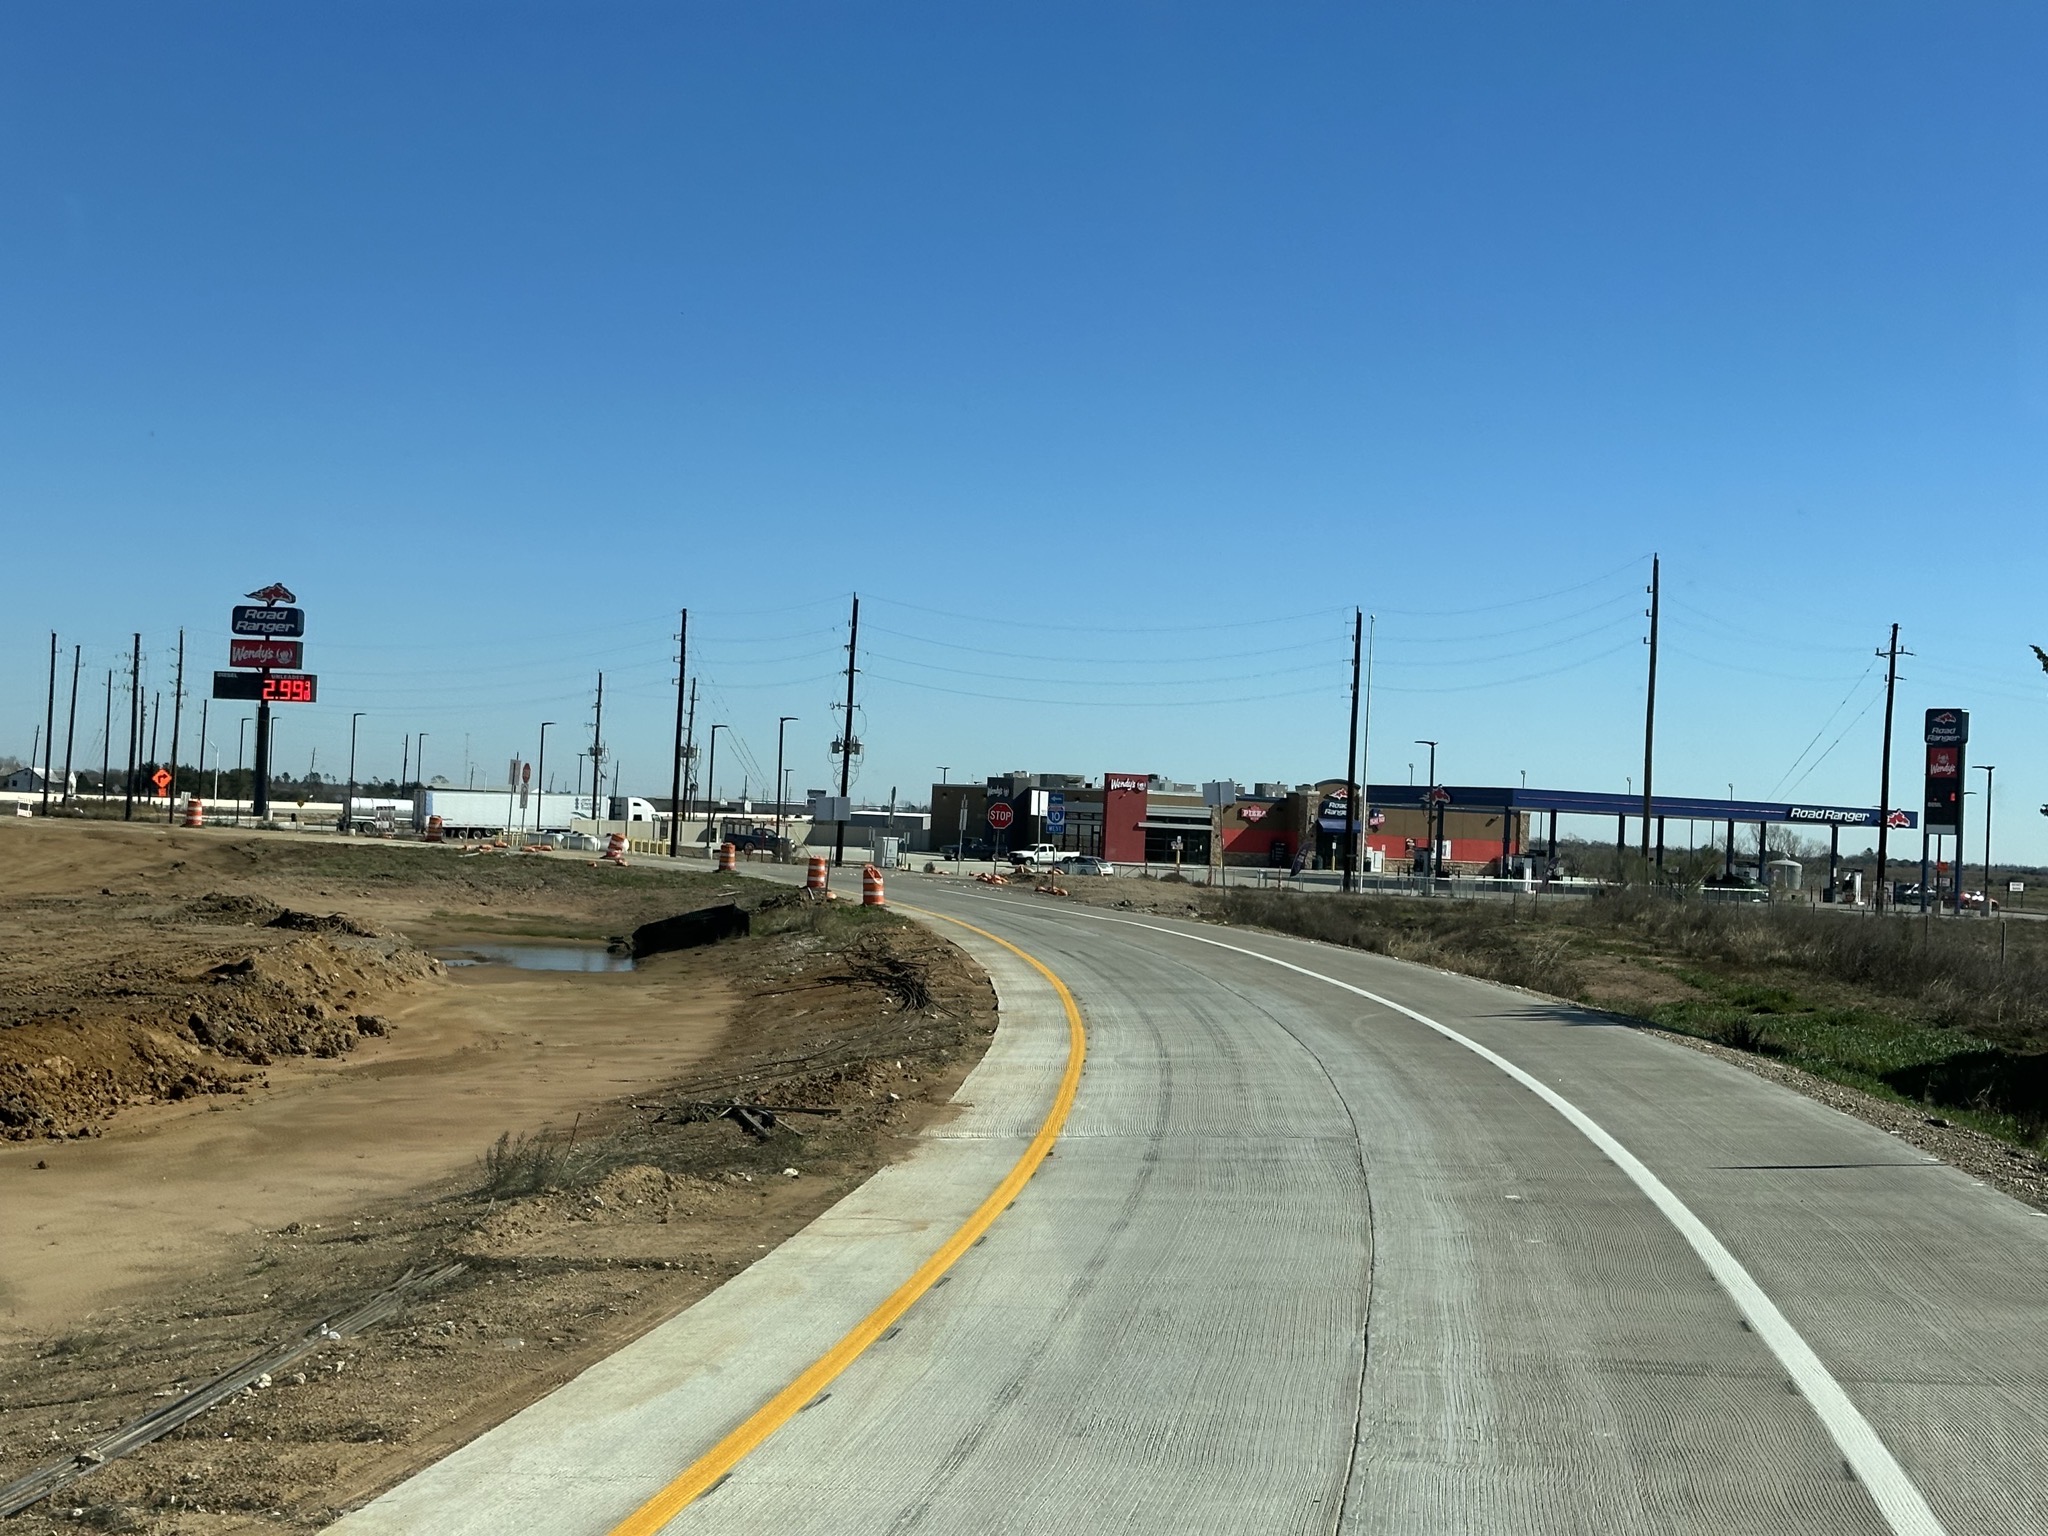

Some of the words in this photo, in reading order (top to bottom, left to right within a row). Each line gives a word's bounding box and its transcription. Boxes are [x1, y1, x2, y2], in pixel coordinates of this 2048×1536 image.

[244, 609, 288, 620] Road
[235, 620, 295, 633] Ranger
[231, 644, 274, 663] Wendy's
[1930, 762, 1956, 776] Wendy's
[1111, 777, 1136, 791] Wendy's
[990, 810, 1012, 821] STOP
[1051, 812, 1061, 822] 10
[1241, 808, 1267, 817] PIZZA
[1324, 808, 1347, 817] Range
[1790, 807, 1825, 819] Road
[1824, 809, 1870, 822] Ranger
